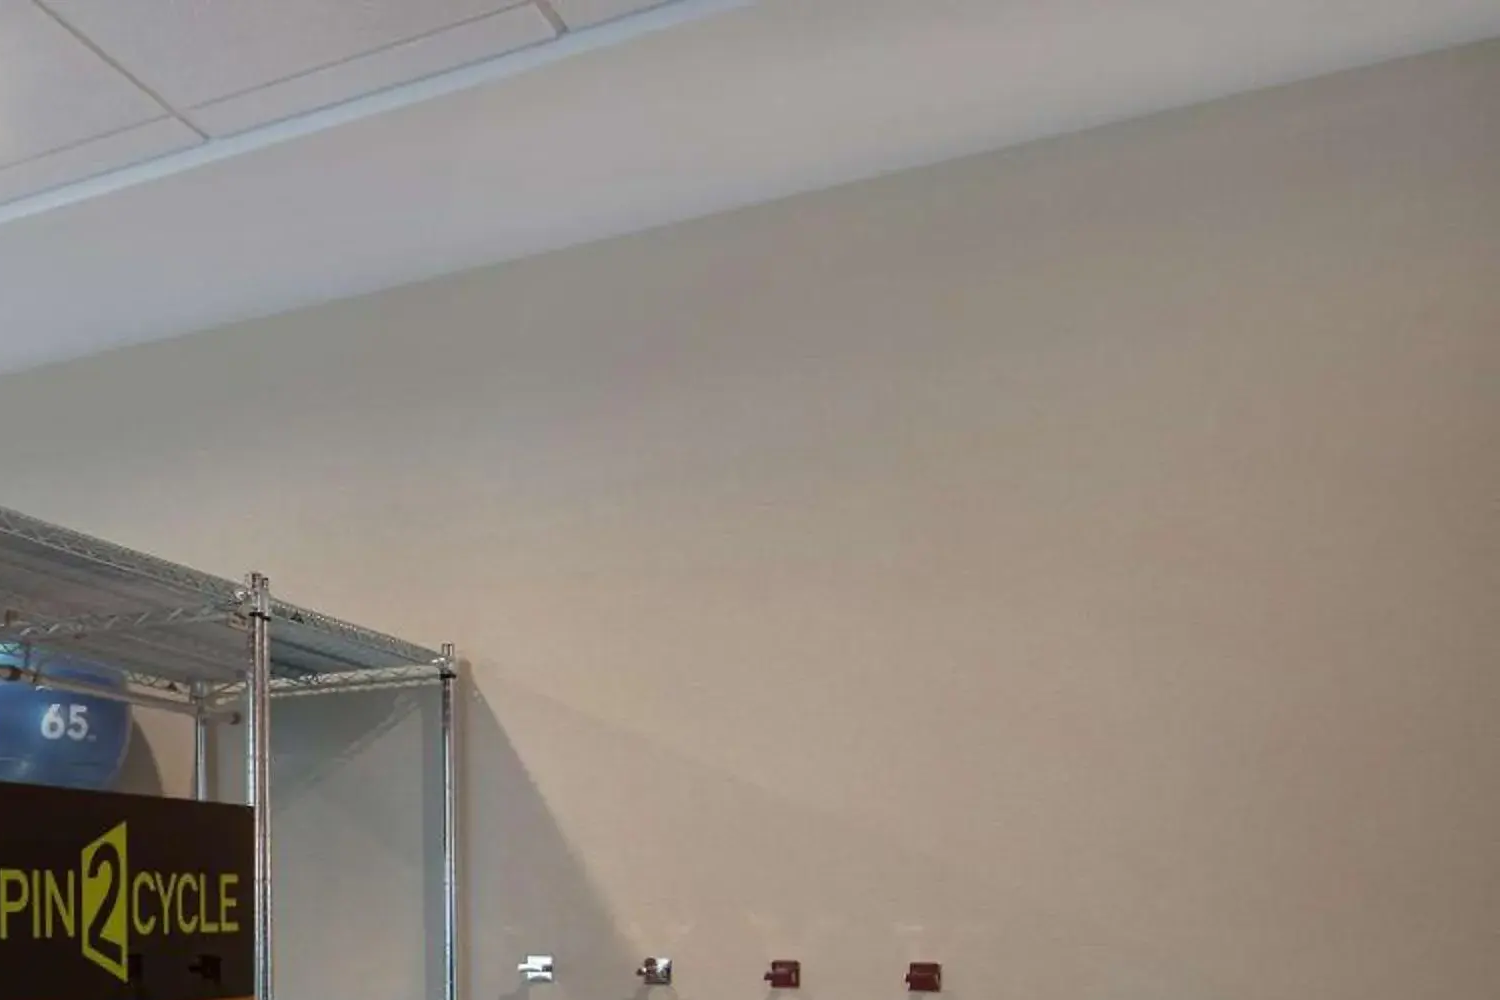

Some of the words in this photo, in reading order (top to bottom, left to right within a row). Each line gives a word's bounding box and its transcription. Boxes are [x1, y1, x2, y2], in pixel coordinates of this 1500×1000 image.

[41, 703, 88, 740] 65
[85, 838, 125, 970] 2
[132, 870, 239, 935] CYCLE
